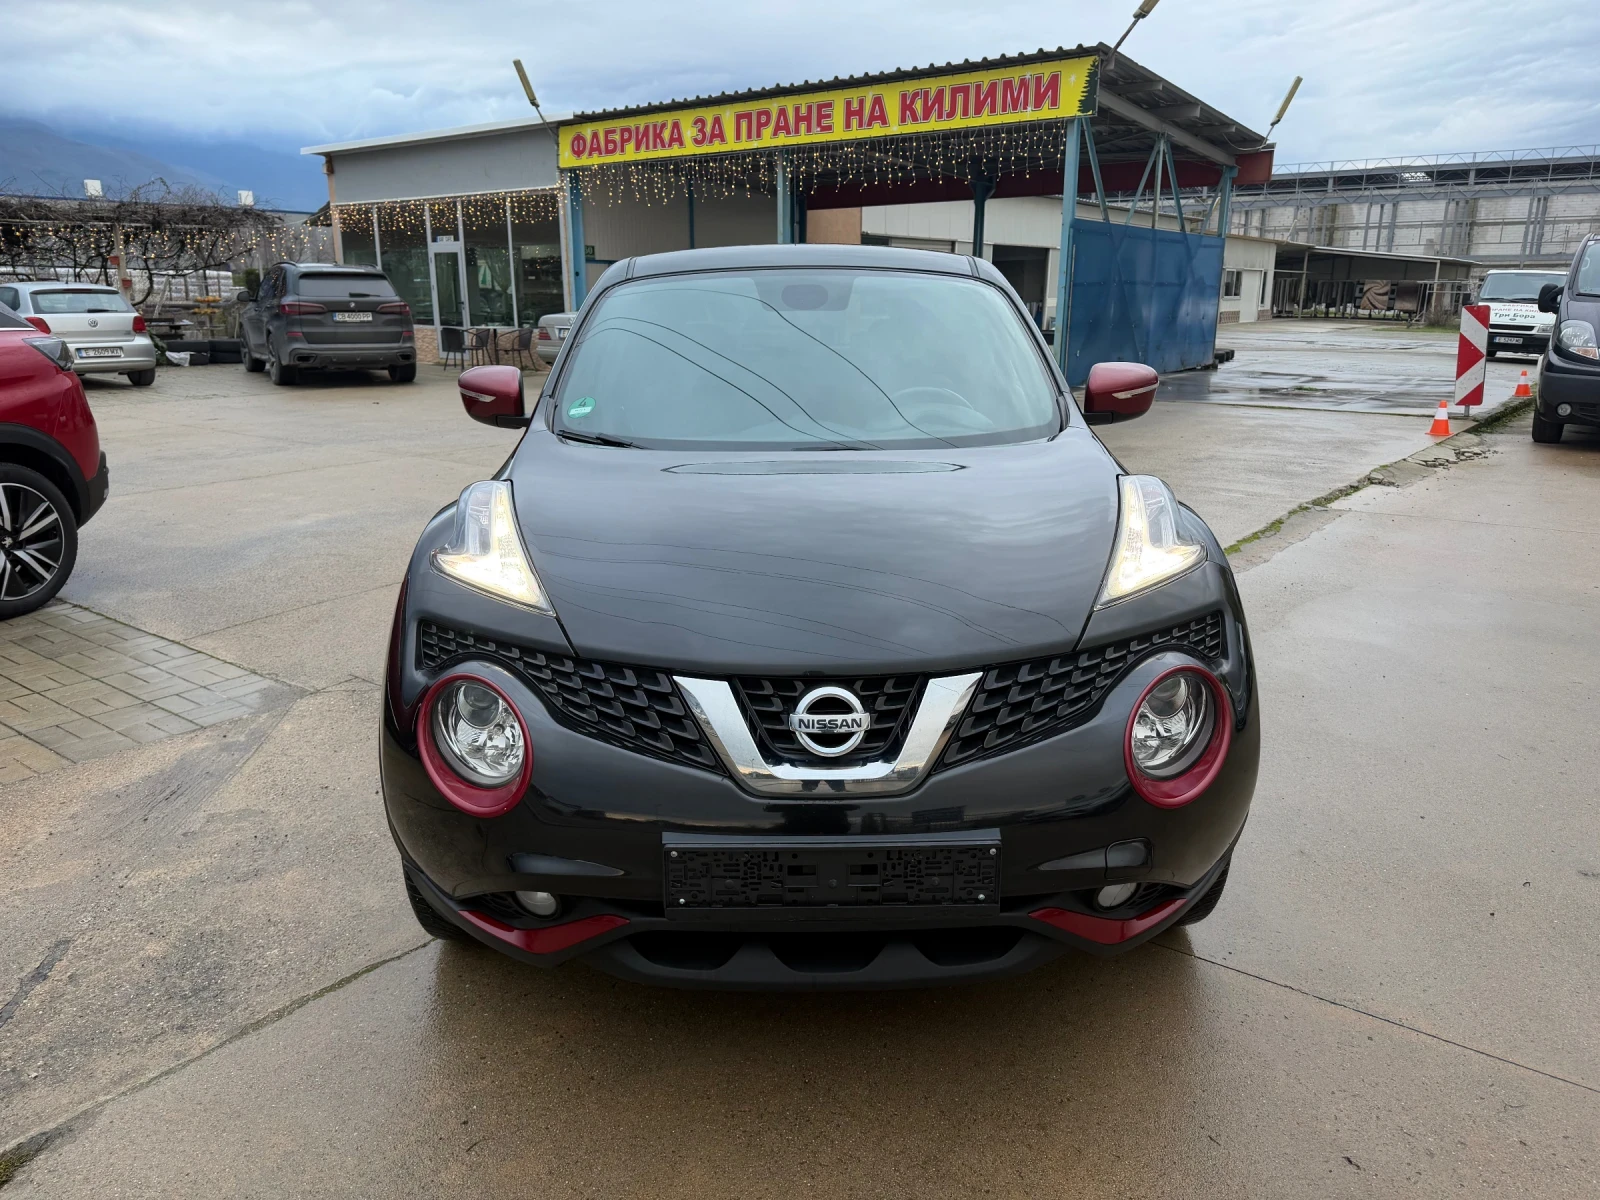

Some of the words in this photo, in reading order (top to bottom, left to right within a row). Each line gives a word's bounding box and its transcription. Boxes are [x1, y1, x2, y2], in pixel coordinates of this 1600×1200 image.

[570, 119, 685, 159] ФАБРИКА
[691, 114, 728, 147] ЗА
[733, 99, 835, 143] ПРАНЕ
[843, 94, 890, 131] НА
[898, 71, 1062, 126] КИЛИМИ
[578, 397, 587, 407] 4
[798, 717, 862, 730] NISSAN
